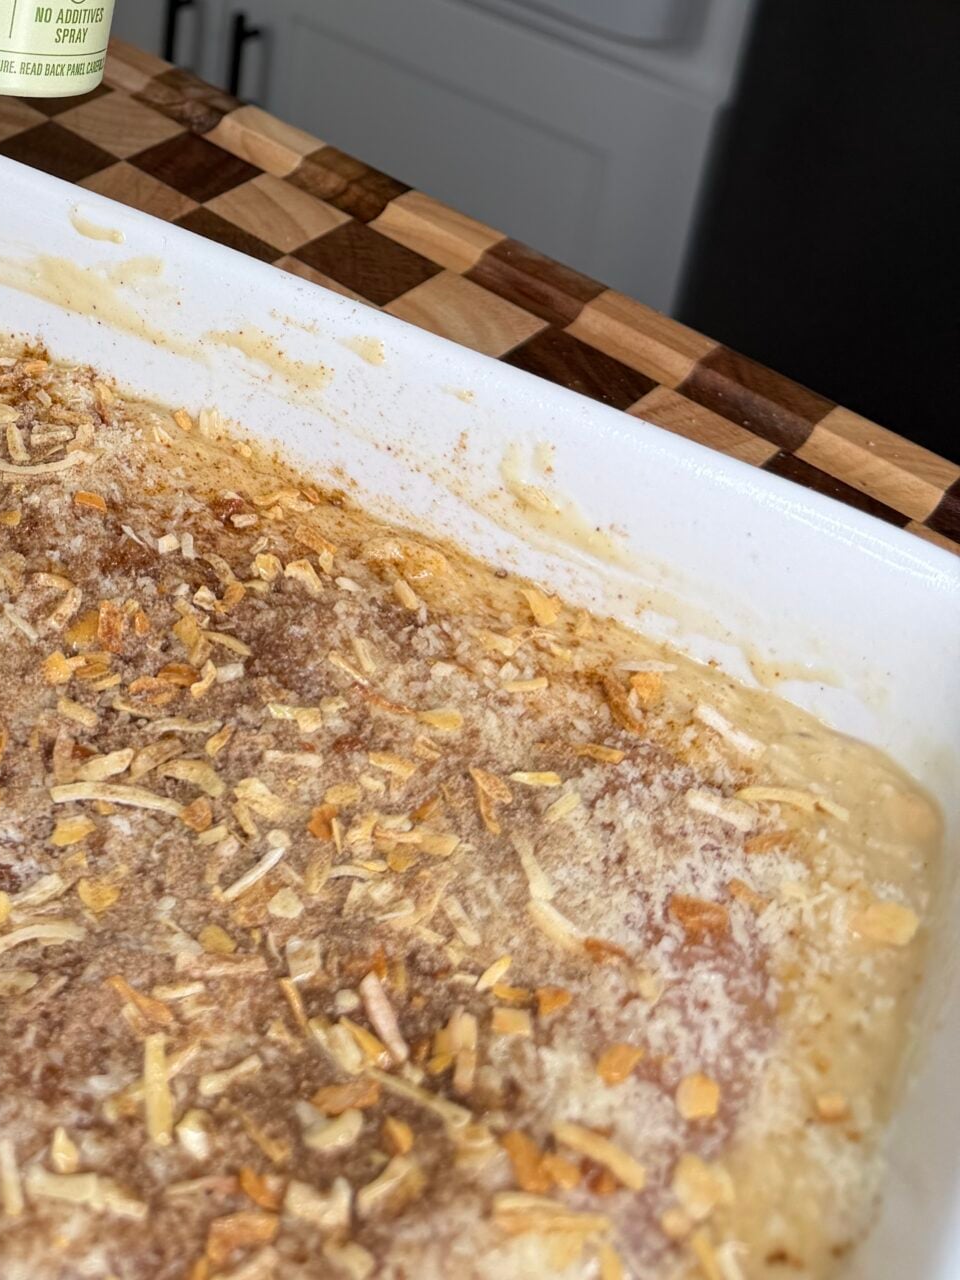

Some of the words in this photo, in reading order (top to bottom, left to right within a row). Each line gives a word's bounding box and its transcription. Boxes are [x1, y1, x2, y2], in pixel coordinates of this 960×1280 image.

[34, 6, 52, 23] NO
[56, 6, 104, 25] ADDITIVES
[54, 27, 88, 44] SPRAY
[19, 61, 43, 76] READ
[44, 63, 65, 76] BACK
[66, 62, 85, 76] PANEL
